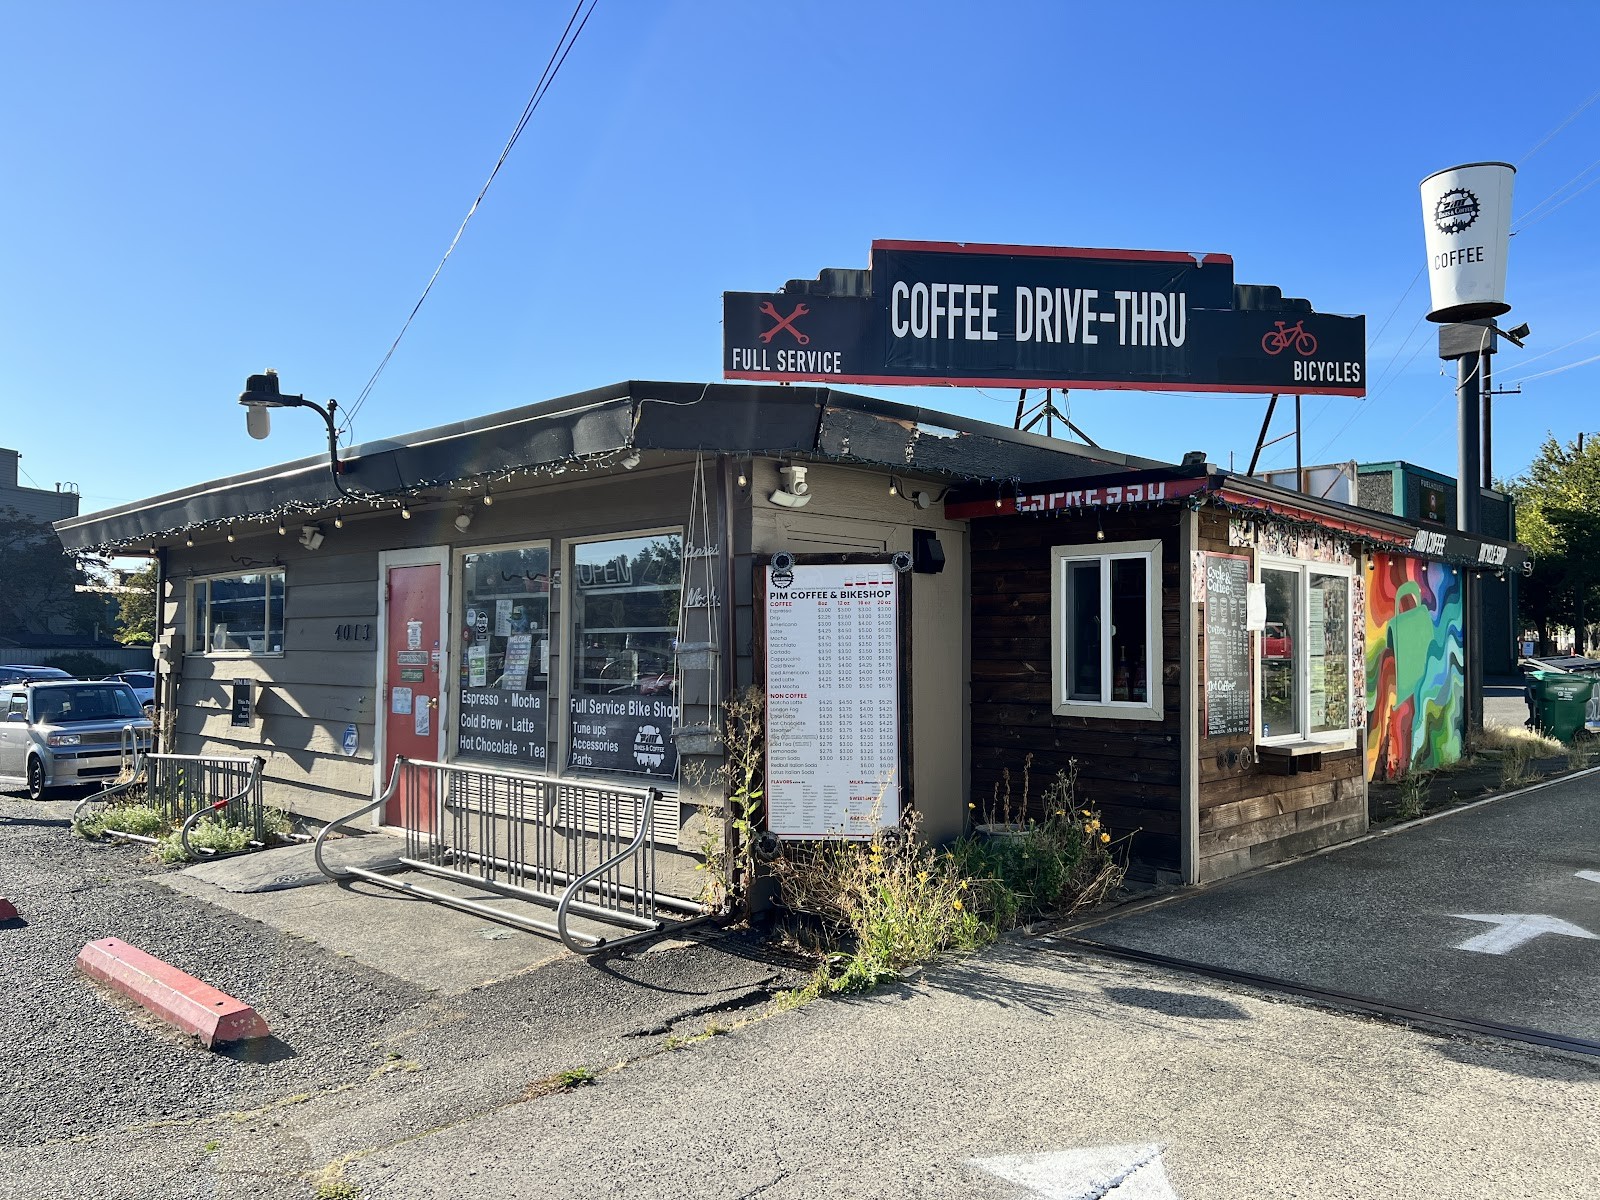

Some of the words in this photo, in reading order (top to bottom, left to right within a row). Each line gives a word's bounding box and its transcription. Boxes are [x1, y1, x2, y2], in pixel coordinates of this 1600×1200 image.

[1435, 246, 1484, 270] COFFEE
[892, 280, 998, 341] COFFEE
[1016, 286, 1186, 347] DRIVE-THRU
[732, 348, 771, 371] FULL
[777, 350, 842, 374] SERVICE
[1294, 360, 1360, 382] BICYCLES
[580, 556, 629, 584] OPEN
[1208, 565, 1226, 580] Cycle
[1226, 572, 1232, 584] &
[840, 590, 891, 598] BIKESHOP
[1207, 579, 1230, 594] Coffee
[462, 690, 499, 708] Espresso
[512, 692, 540, 708] Mocha
[570, 699, 587, 714] Full
[589, 699, 626, 715] Service
[628, 701, 651, 717] Bike
[653, 701, 680, 721] Shop
[460, 713, 479, 728] Cold
[481, 714, 502, 730] Brew
[512, 717, 534, 733] Latte
[572, 722, 591, 734] Tune
[593, 725, 607, 737] ups
[460, 735, 474, 750] Hot
[476, 736, 518, 755] Chocolate
[529, 742, 546, 758] Tea
[572, 737, 619, 752] Accessories
[572, 753, 592, 766] Parts
